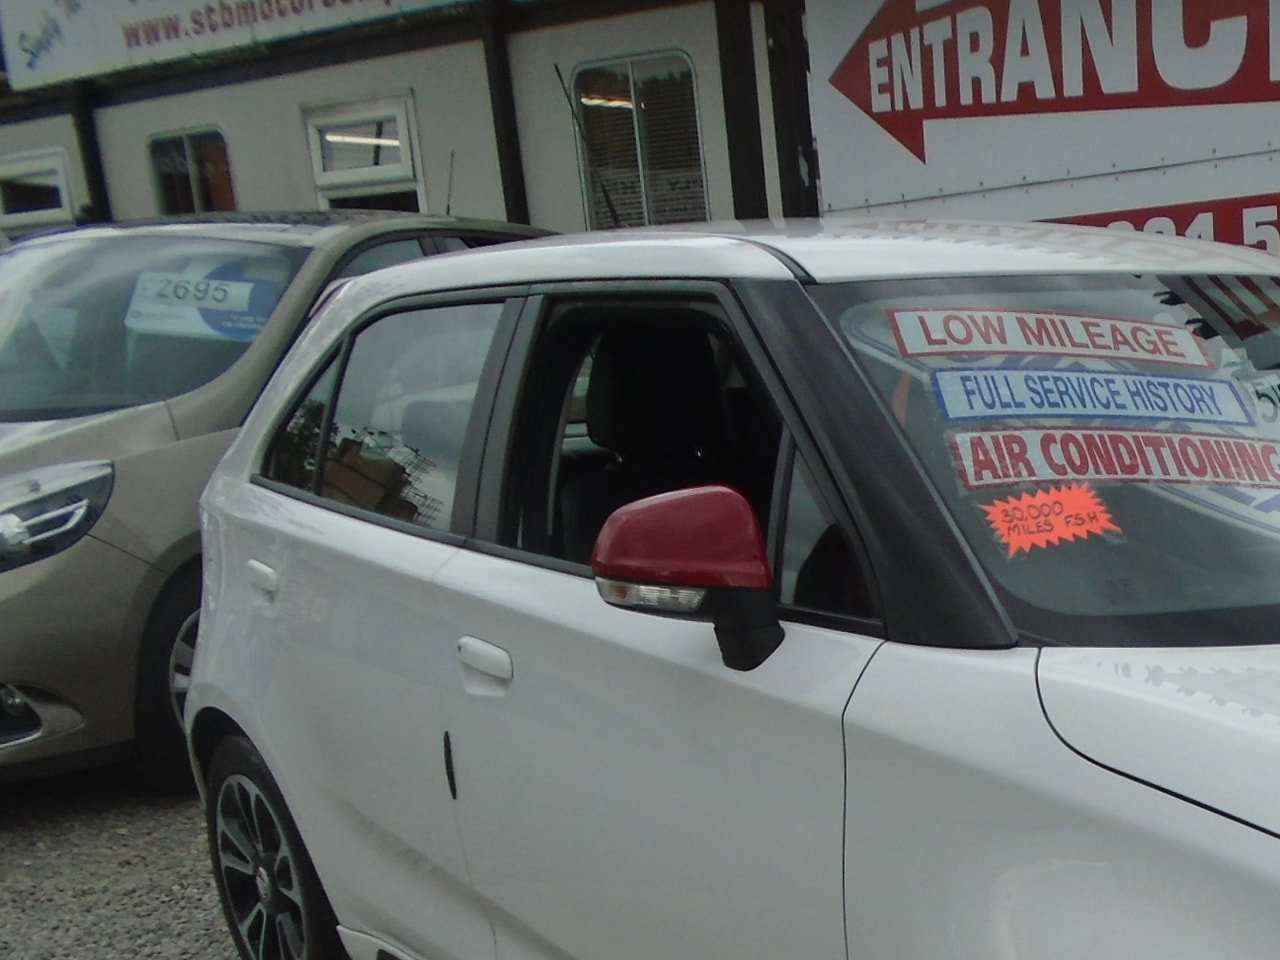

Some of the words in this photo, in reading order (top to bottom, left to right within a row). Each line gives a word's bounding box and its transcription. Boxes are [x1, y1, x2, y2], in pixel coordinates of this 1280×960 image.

[918, 314, 1009, 346] LOW
[1015, 316, 1186, 358] MILEAGE
[960, 374, 1026, 410] FULL
[1024, 375, 1127, 412] SERVICE
[1126, 378, 1223, 416] HISTORY
[969, 434, 1037, 482] AIR
[1008, 520, 1054, 537] MILES
